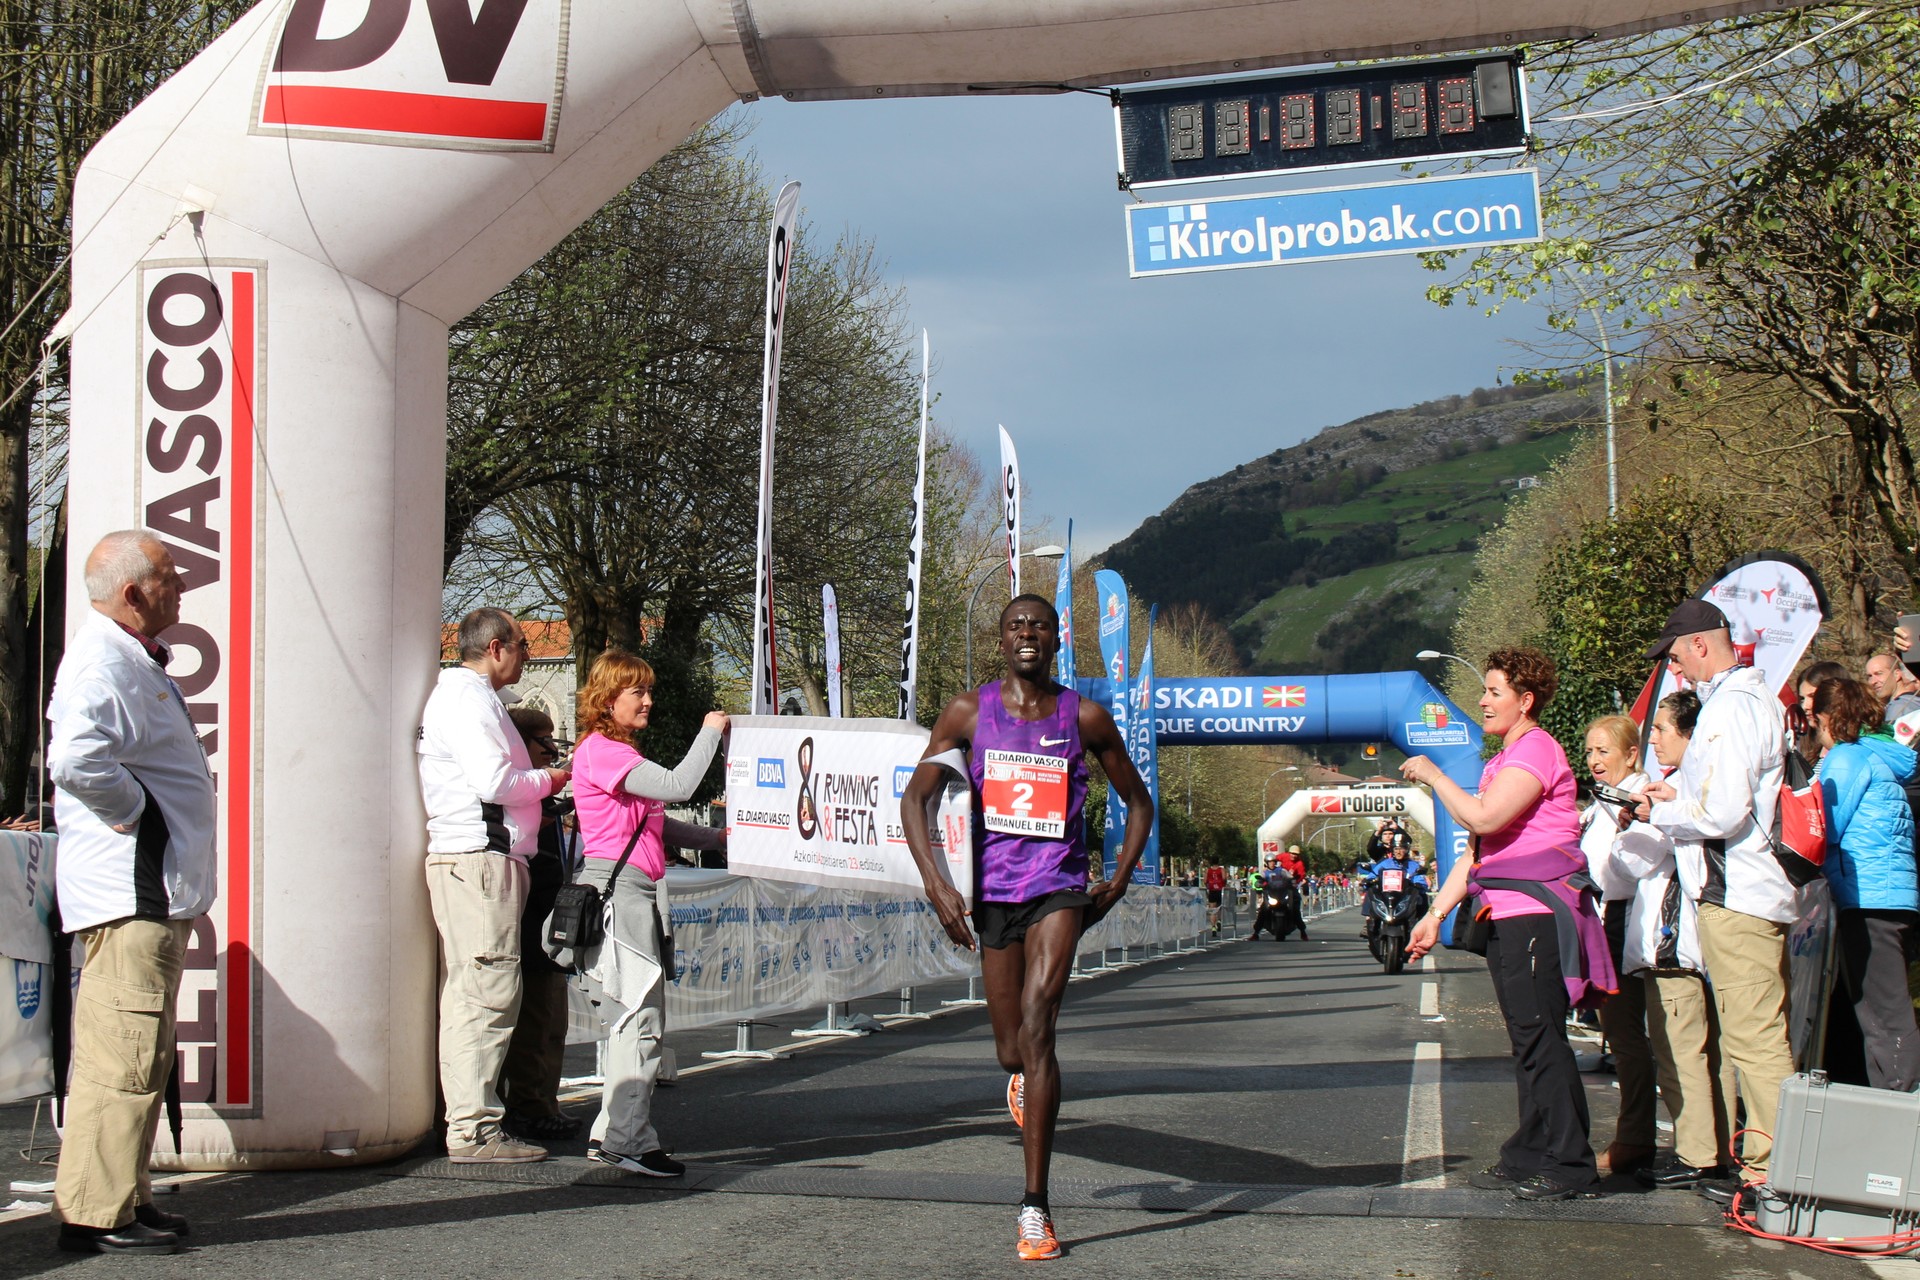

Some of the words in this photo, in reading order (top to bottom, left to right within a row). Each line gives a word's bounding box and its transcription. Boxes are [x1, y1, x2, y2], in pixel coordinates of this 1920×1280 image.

[272, 0, 527, 86] DV
[1169, 201, 1522, 262] Kirolprobak.com
[1775, 597, 1816, 610] Occidente
[1777, 588, 1813, 602] Catalana
[1129, 686, 1253, 708] SKADI
[1200, 716, 1306, 734] COUNTRY
[1032, 756, 1065, 768] VASCO
[759, 763, 784, 783] BBVA
[1011, 782, 1034, 810] 2
[1342, 794, 1405, 812] robers
[737, 810, 745, 821] EL
[745, 811, 768, 823] DIARIO
[768, 812, 790, 826] VASCO
[835, 807, 878, 846] FESTA
[987, 816, 1032, 831] EMMANUEL
[1035, 822, 1060, 834] BETT
[1868, 1178, 1894, 1187] MYLAPS
